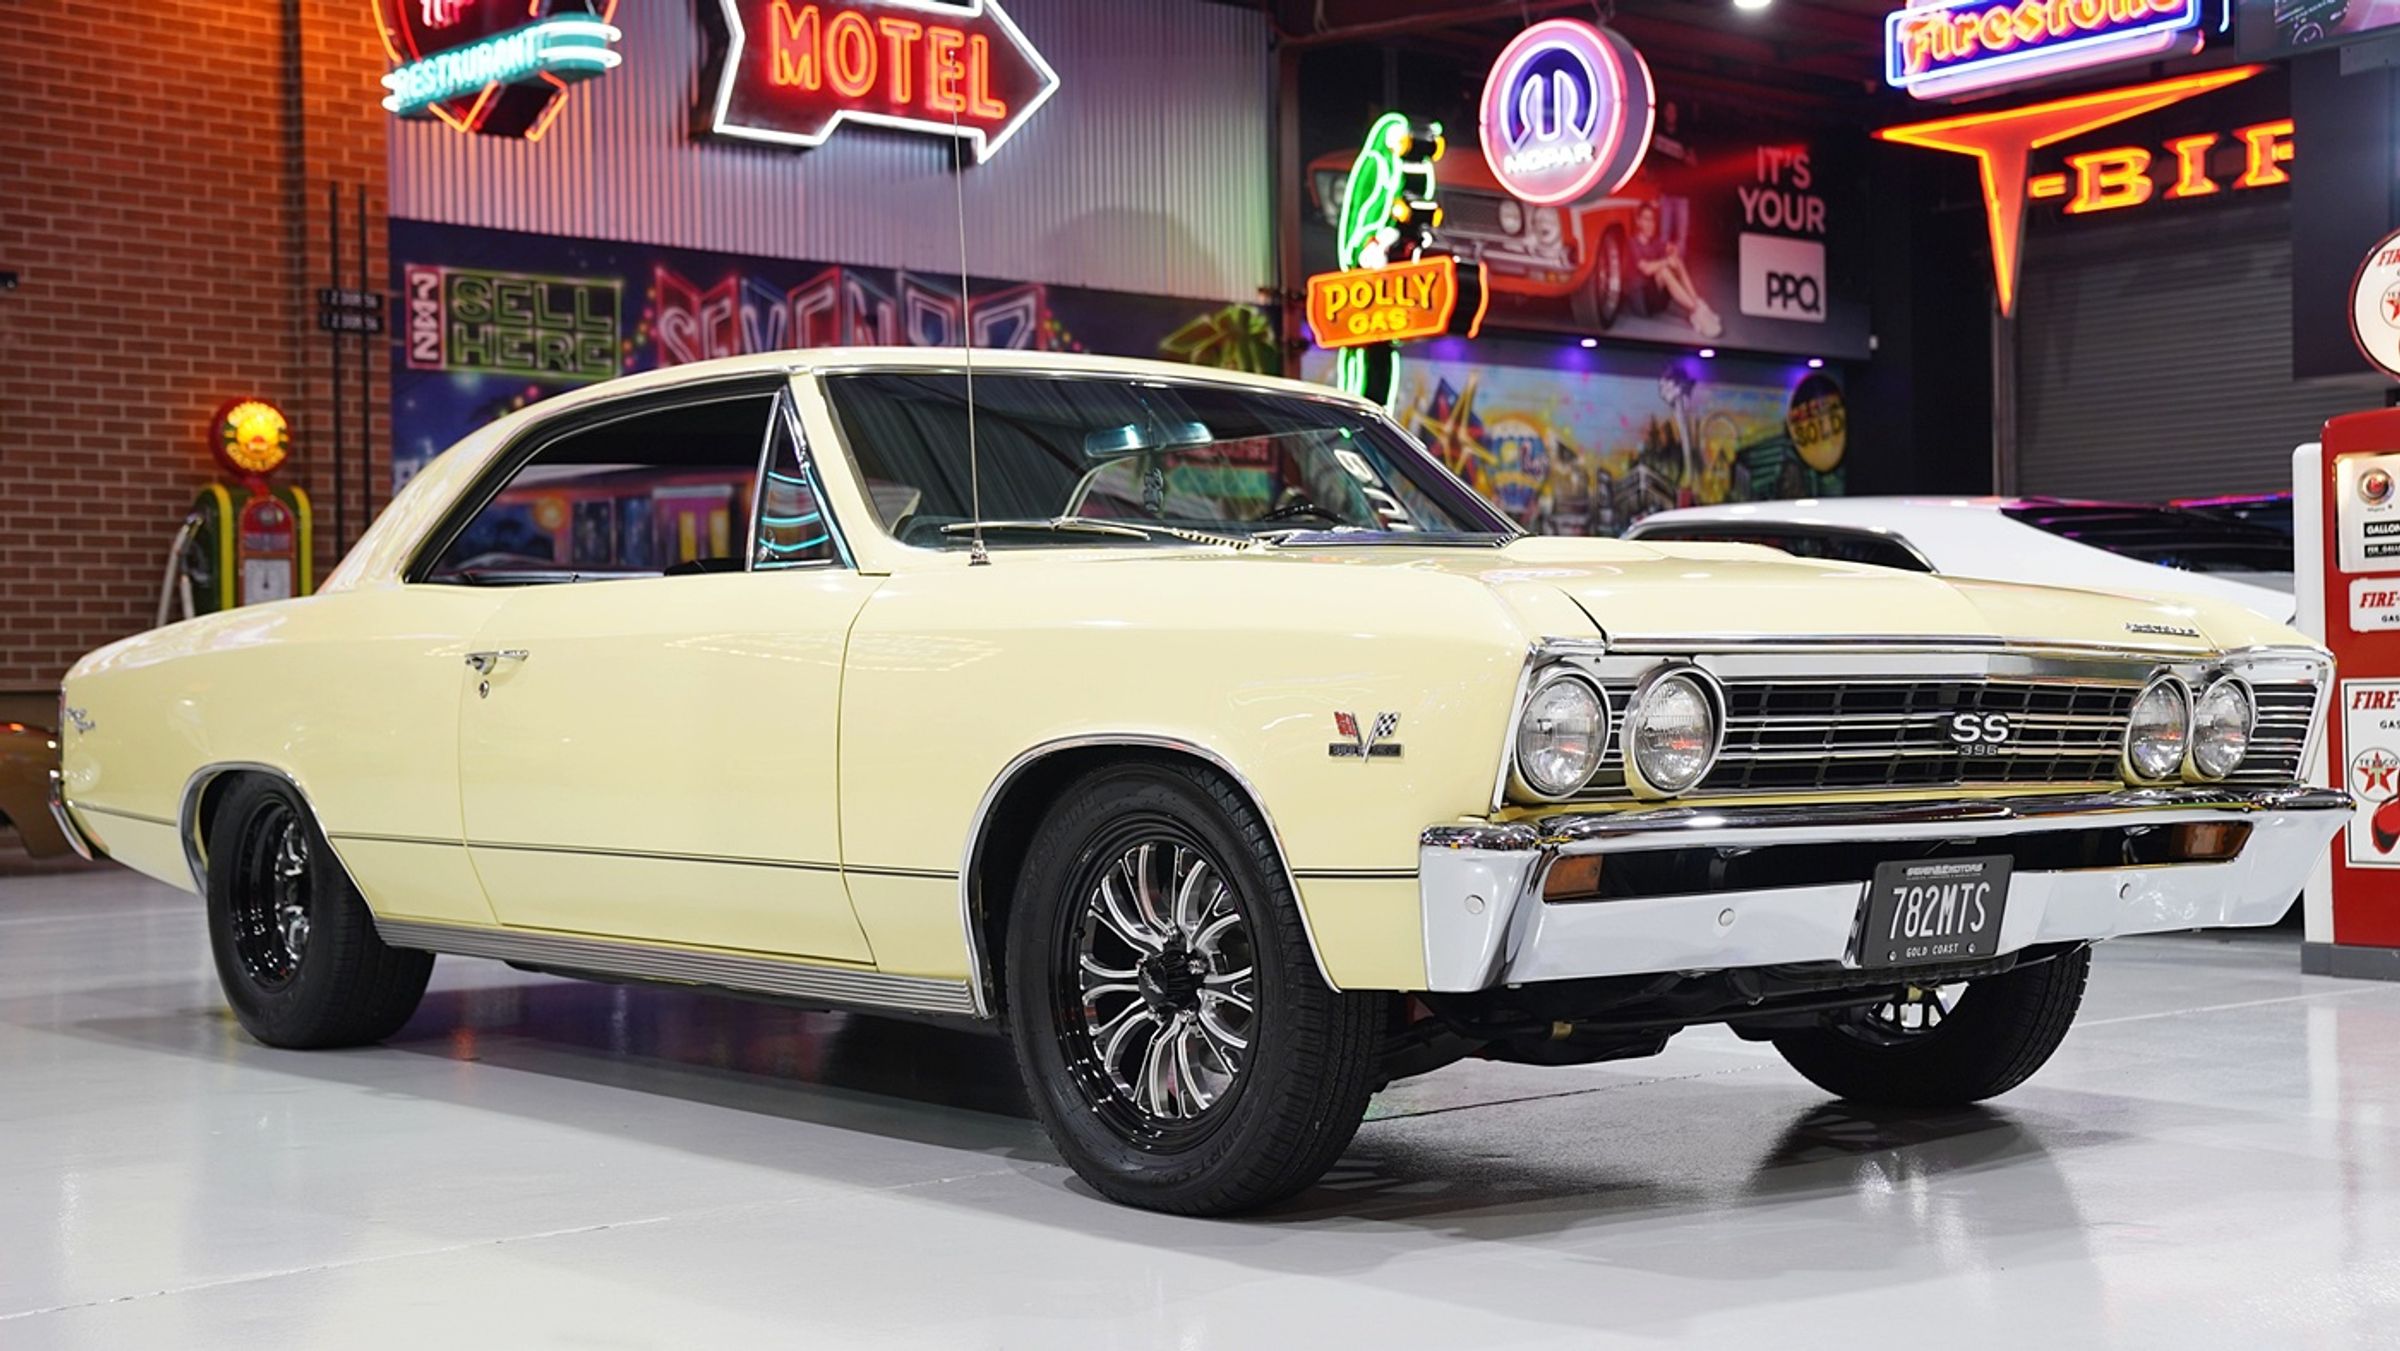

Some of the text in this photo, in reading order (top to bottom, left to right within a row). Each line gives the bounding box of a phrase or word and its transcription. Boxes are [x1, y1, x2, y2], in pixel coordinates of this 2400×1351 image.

[393, 26, 541, 102] RESTAURANT
[768, 0, 1007, 119] MOTEL
[1503, 141, 1597, 175] MOPAR
[1757, 145, 1811, 190] IT'S
[1737, 185, 1826, 234] YOUR
[451, 275, 614, 332] SELL
[1323, 270, 1437, 322] POLLY
[1766, 270, 1821, 313] PPQ
[1347, 307, 1410, 335] GAS
[452, 322, 614, 376] HERE
[1951, 714, 2009, 743] SS
[1961, 744, 1998, 756] 396
[1889, 881, 1990, 940] 782MTS
[1906, 942, 1959, 958] GOLD COAST
